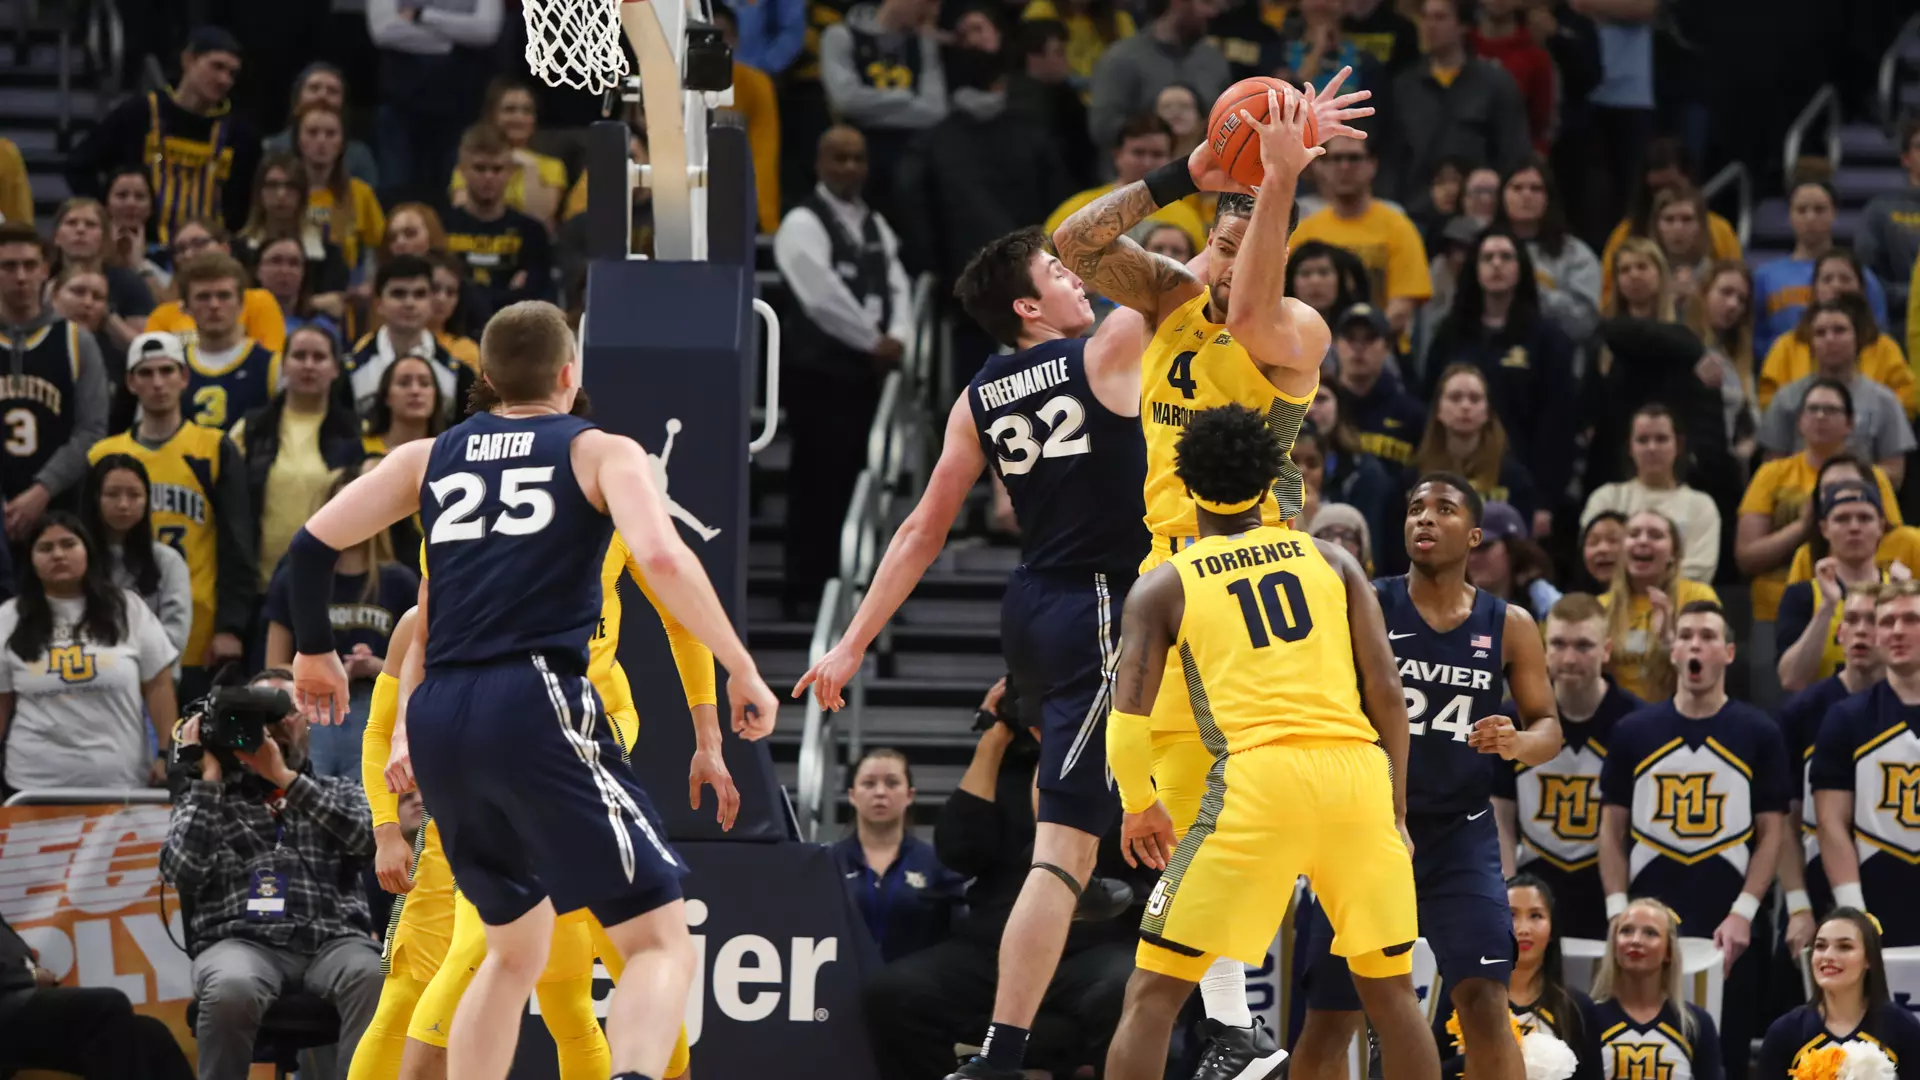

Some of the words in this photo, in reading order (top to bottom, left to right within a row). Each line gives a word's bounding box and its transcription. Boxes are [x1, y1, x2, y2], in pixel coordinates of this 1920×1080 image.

[1213, 112, 1241, 156] ELITE
[978, 357, 1070, 412] FREEMANTLE
[1167, 350, 1198, 399] 4
[4, 408, 38, 456] 3
[193, 385, 228, 427] 3
[465, 432, 535, 462] CARTER
[984, 394, 1091, 477] 32
[429, 466, 556, 544] 25
[1191, 541, 1305, 578] TORRENCE
[1226, 570, 1313, 649] 10
[47, 644, 98, 684] MU
[1403, 686, 1475, 742] 24
[1533, 772, 1601, 842] MU
[1651, 772, 1727, 838] MU
